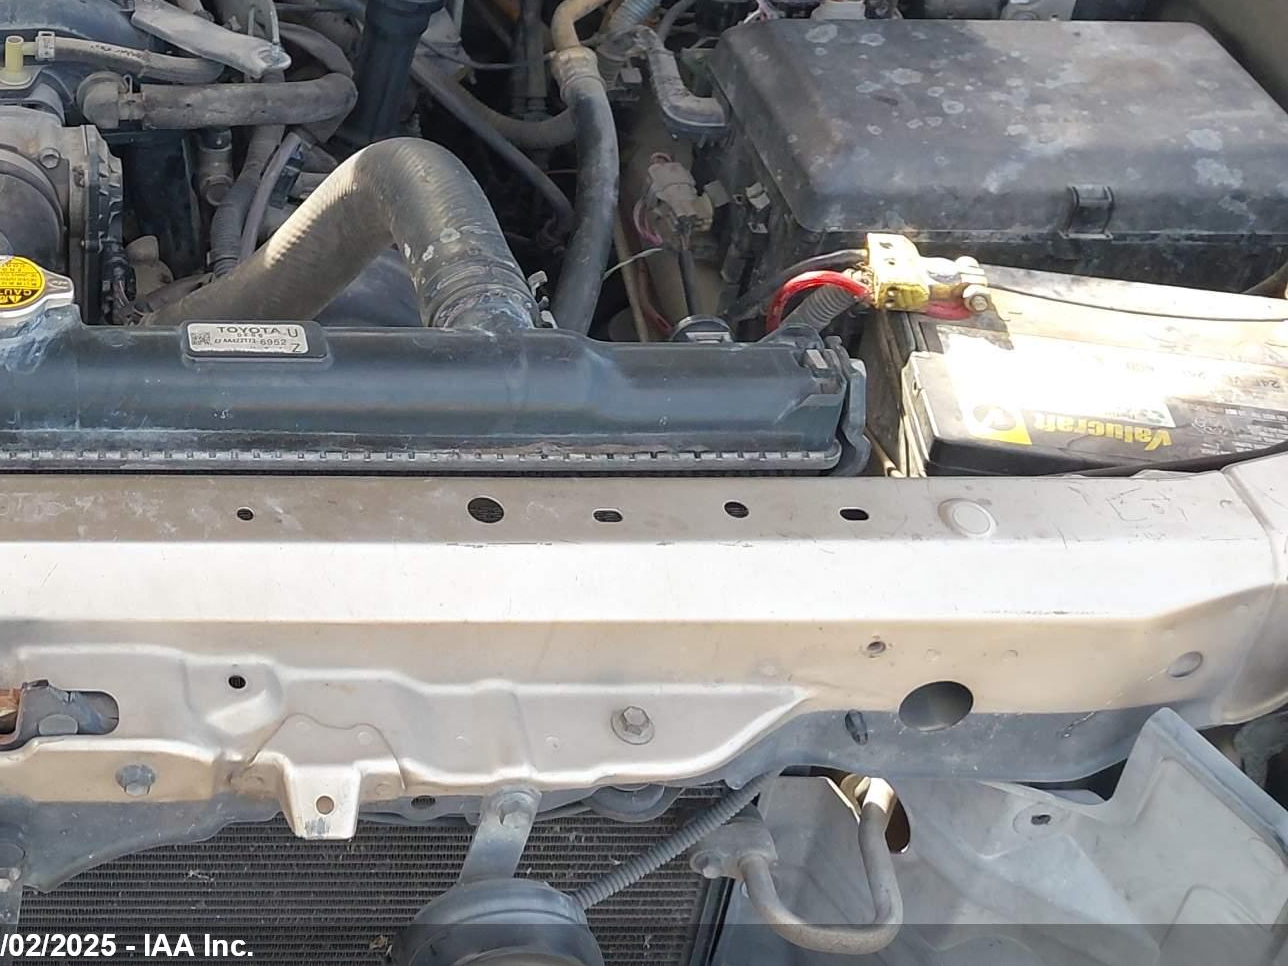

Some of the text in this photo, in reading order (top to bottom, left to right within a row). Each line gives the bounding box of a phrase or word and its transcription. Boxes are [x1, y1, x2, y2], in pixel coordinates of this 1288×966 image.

[216, 326, 280, 334] TOYOTA
[287, 328, 298, 338] U
[1033, 411, 1173, 451] Valucraft
